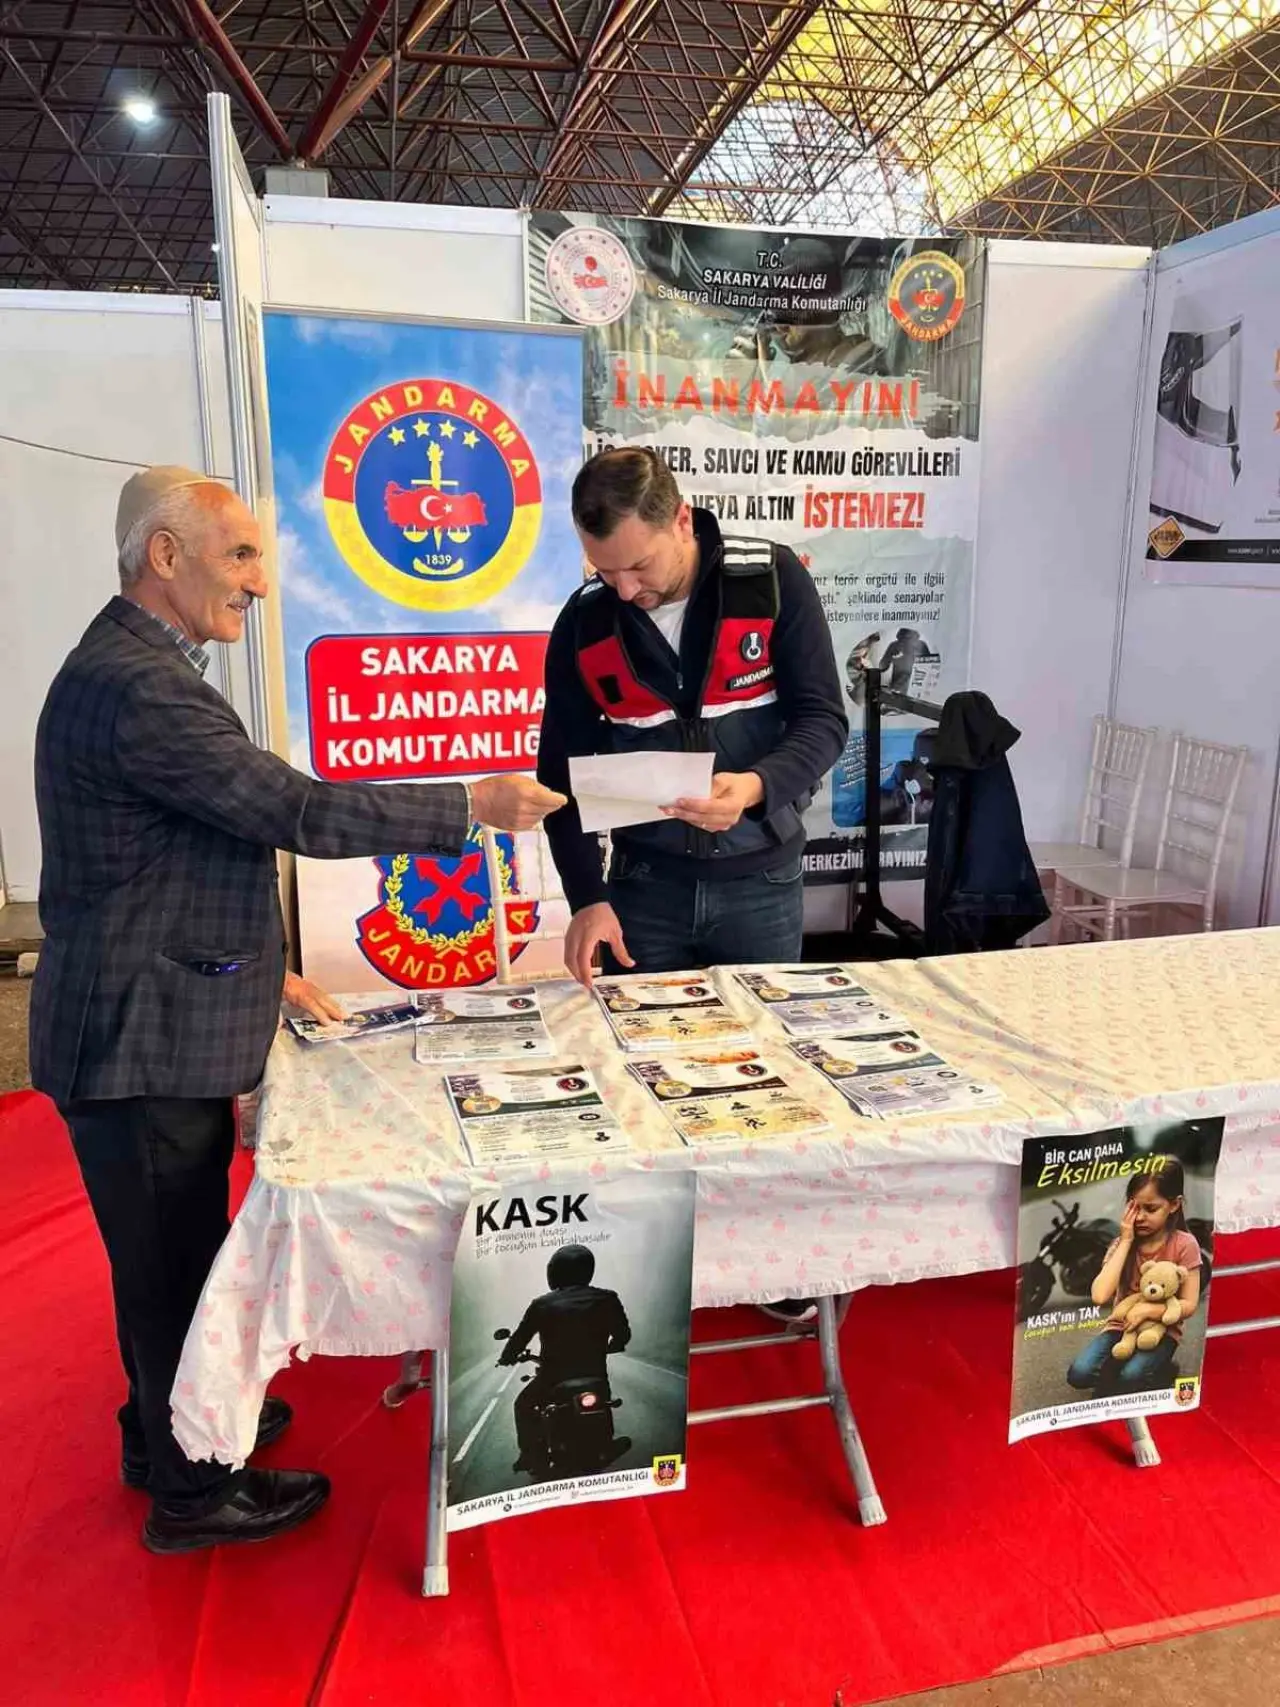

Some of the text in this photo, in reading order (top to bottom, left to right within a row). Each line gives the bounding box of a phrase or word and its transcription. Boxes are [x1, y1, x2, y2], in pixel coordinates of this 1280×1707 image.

[757, 252, 783, 268] T.C.
[703, 269, 828, 290] SAKARYA VALİLİĞİ
[657, 284, 709, 306] Sakarya
[724, 291, 788, 310] Jandarma
[791, 296, 867, 314] Komutanlığı
[611, 359, 920, 418] İNANMAYIN!
[333, 384, 531, 479] JANDARMA
[704, 448, 759, 475] SAVCI
[766, 449, 787, 475] VE
[792, 450, 845, 475] KAMU
[851, 444, 961, 477] GÖREVLİLERİ
[745, 495, 795, 520] ALTIN
[803, 483, 926, 529] İSTEMEZ!
[425, 554, 452, 566] 1839
[904, 573, 917, 586] ile
[923, 572, 945, 588] ilgili
[847, 590, 887, 606] şeklinde
[894, 591, 945, 605] senaryolar
[361, 644, 520, 677] SAKARYA
[327, 686, 546, 723] İL JANDARMA
[327, 722, 541, 769] KOMUTANLIĞ
[879, 850, 928, 868] RAYINIZ
[368, 909, 532, 983] JANDARA
[1036, 1152, 1168, 1188] Eksilmesin
[1045, 1142, 1124, 1165] BİR CAN DAHA
[475, 1193, 590, 1237] KASK
[1078, 1305, 1101, 1320] TAK
[1063, 1400, 1110, 1416] JANDARMA
[456, 1496, 505, 1516] SAKARYA
[506, 1493, 516, 1503] İL
[518, 1480, 576, 1499] JANDARMA
[578, 1470, 650, 1489] KOMUTANLIĞI
